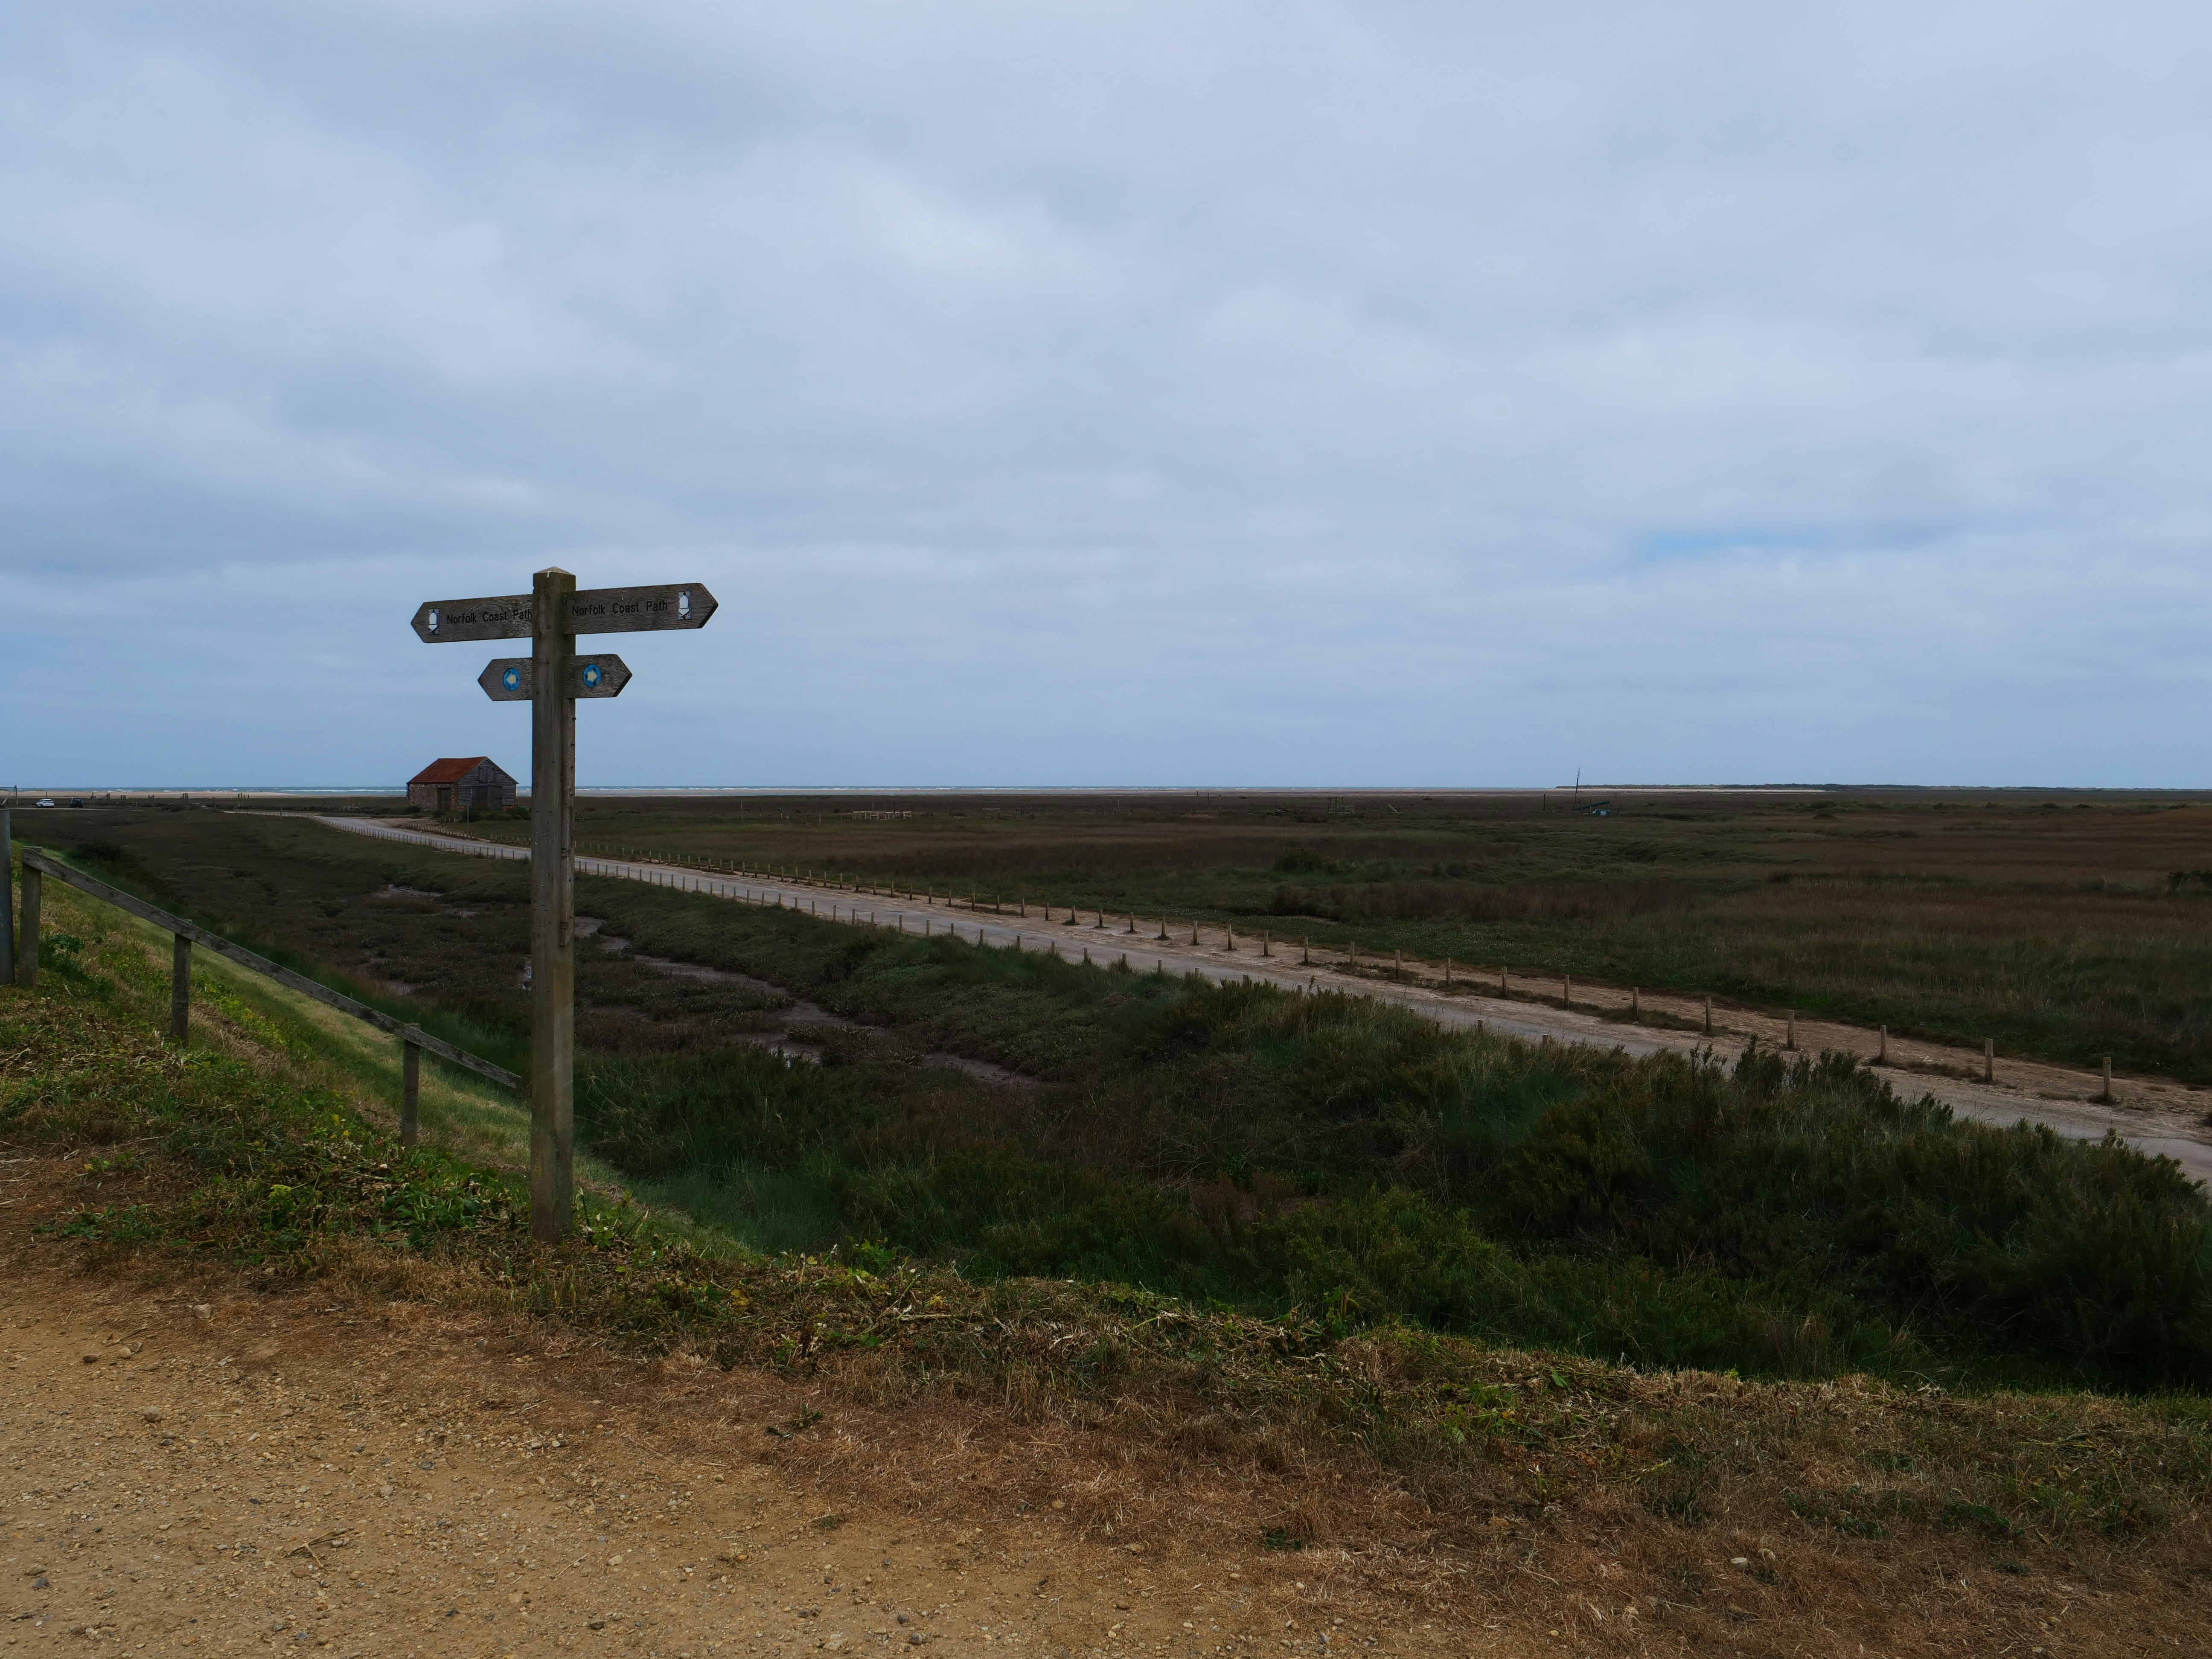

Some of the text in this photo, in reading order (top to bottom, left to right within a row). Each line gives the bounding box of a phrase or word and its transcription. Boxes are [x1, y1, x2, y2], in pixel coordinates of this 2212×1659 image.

[572, 600, 668, 616] Norfolk Coast Path
[447, 609, 532, 624] Norfolk Coast Path
